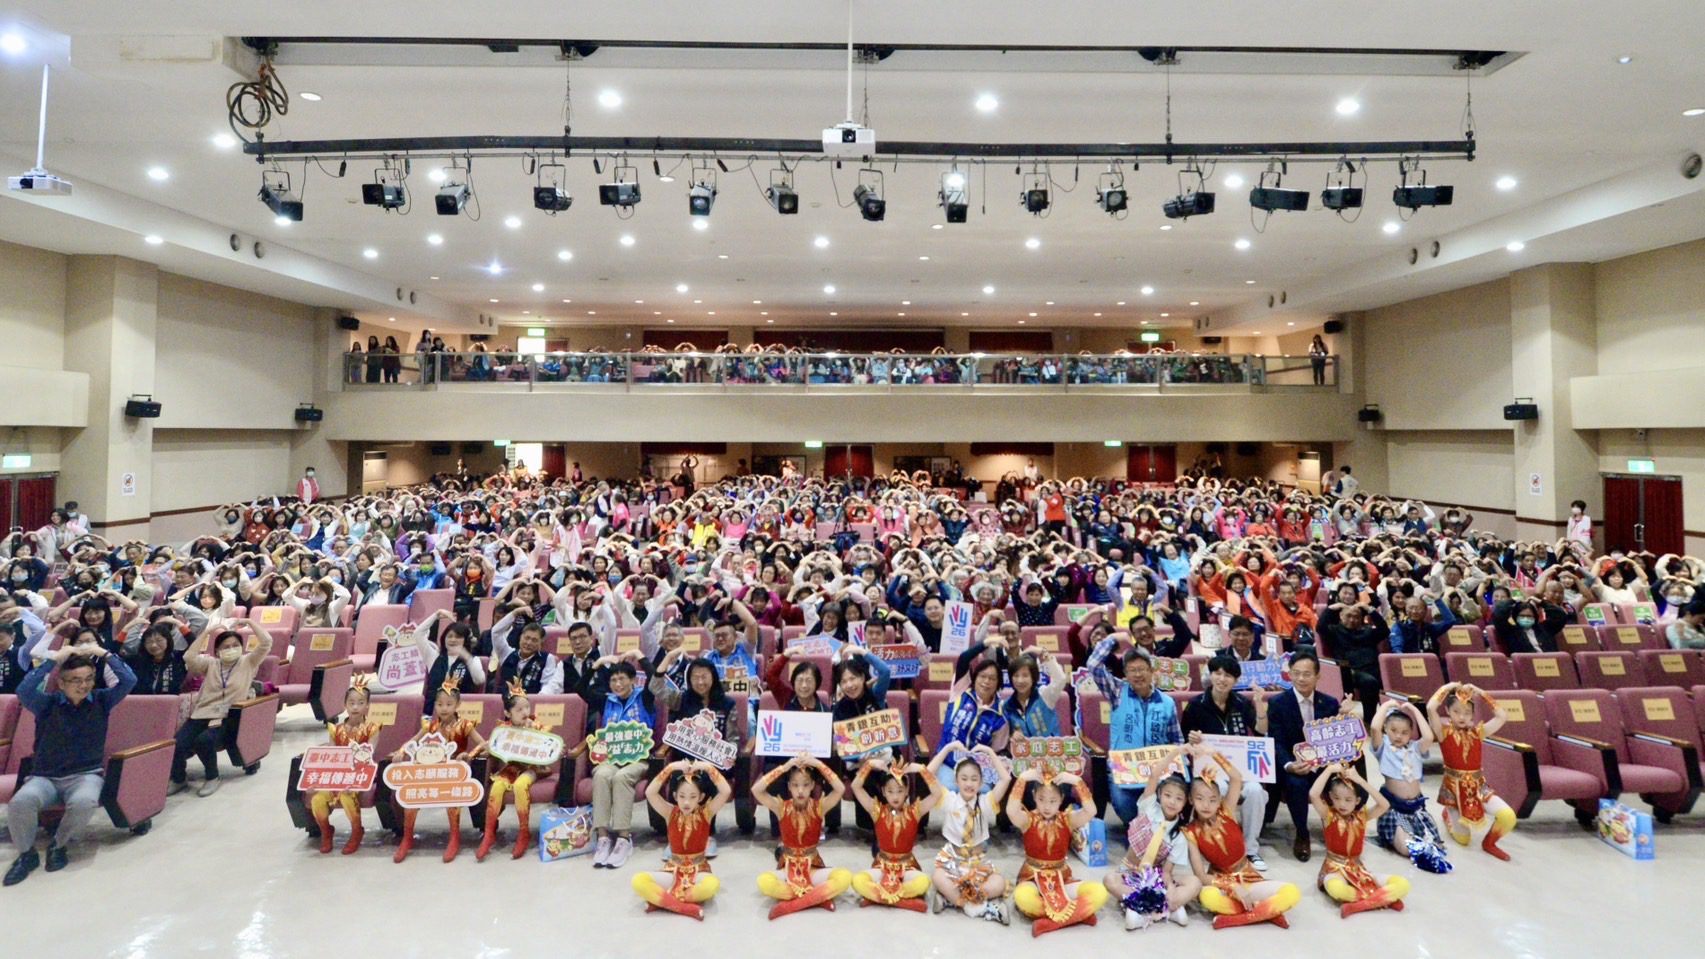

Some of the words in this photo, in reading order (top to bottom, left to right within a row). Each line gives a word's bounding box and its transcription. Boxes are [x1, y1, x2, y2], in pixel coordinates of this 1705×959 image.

[846, 713, 891, 732] 青銀互助
[1311, 722, 1357, 742] 高齡志工
[763, 743, 781, 752] 26
